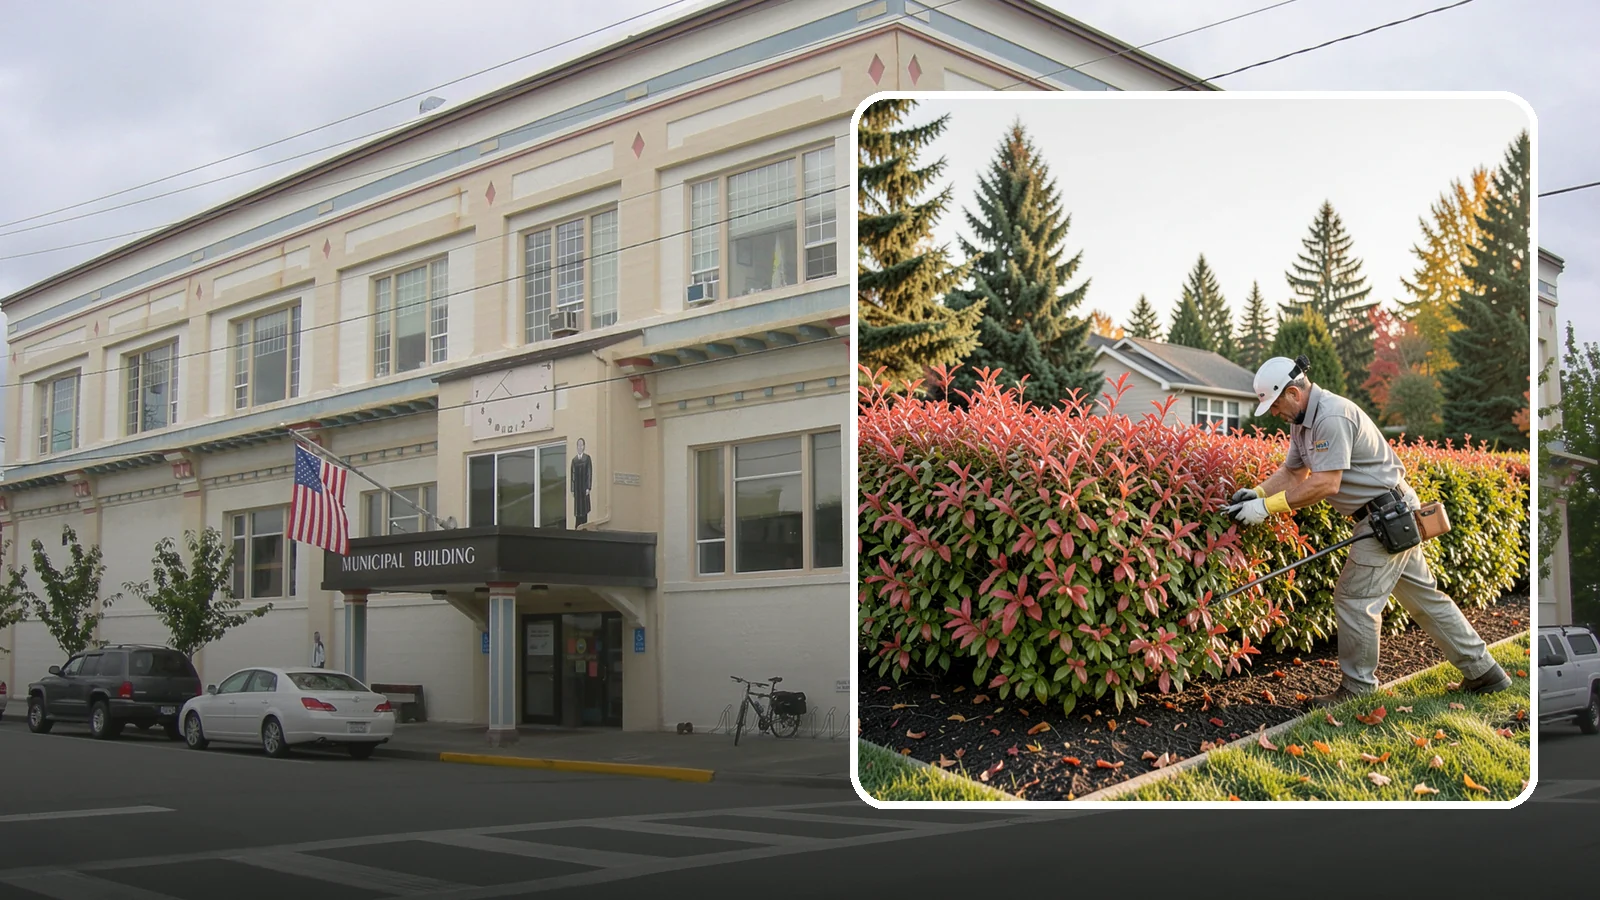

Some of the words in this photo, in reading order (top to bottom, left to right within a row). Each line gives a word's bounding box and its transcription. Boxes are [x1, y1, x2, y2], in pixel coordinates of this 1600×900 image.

[494, 424, 500, 432] 10
[342, 552, 405, 572] MUNICIPAL
[414, 546, 475, 567] BUILDING
